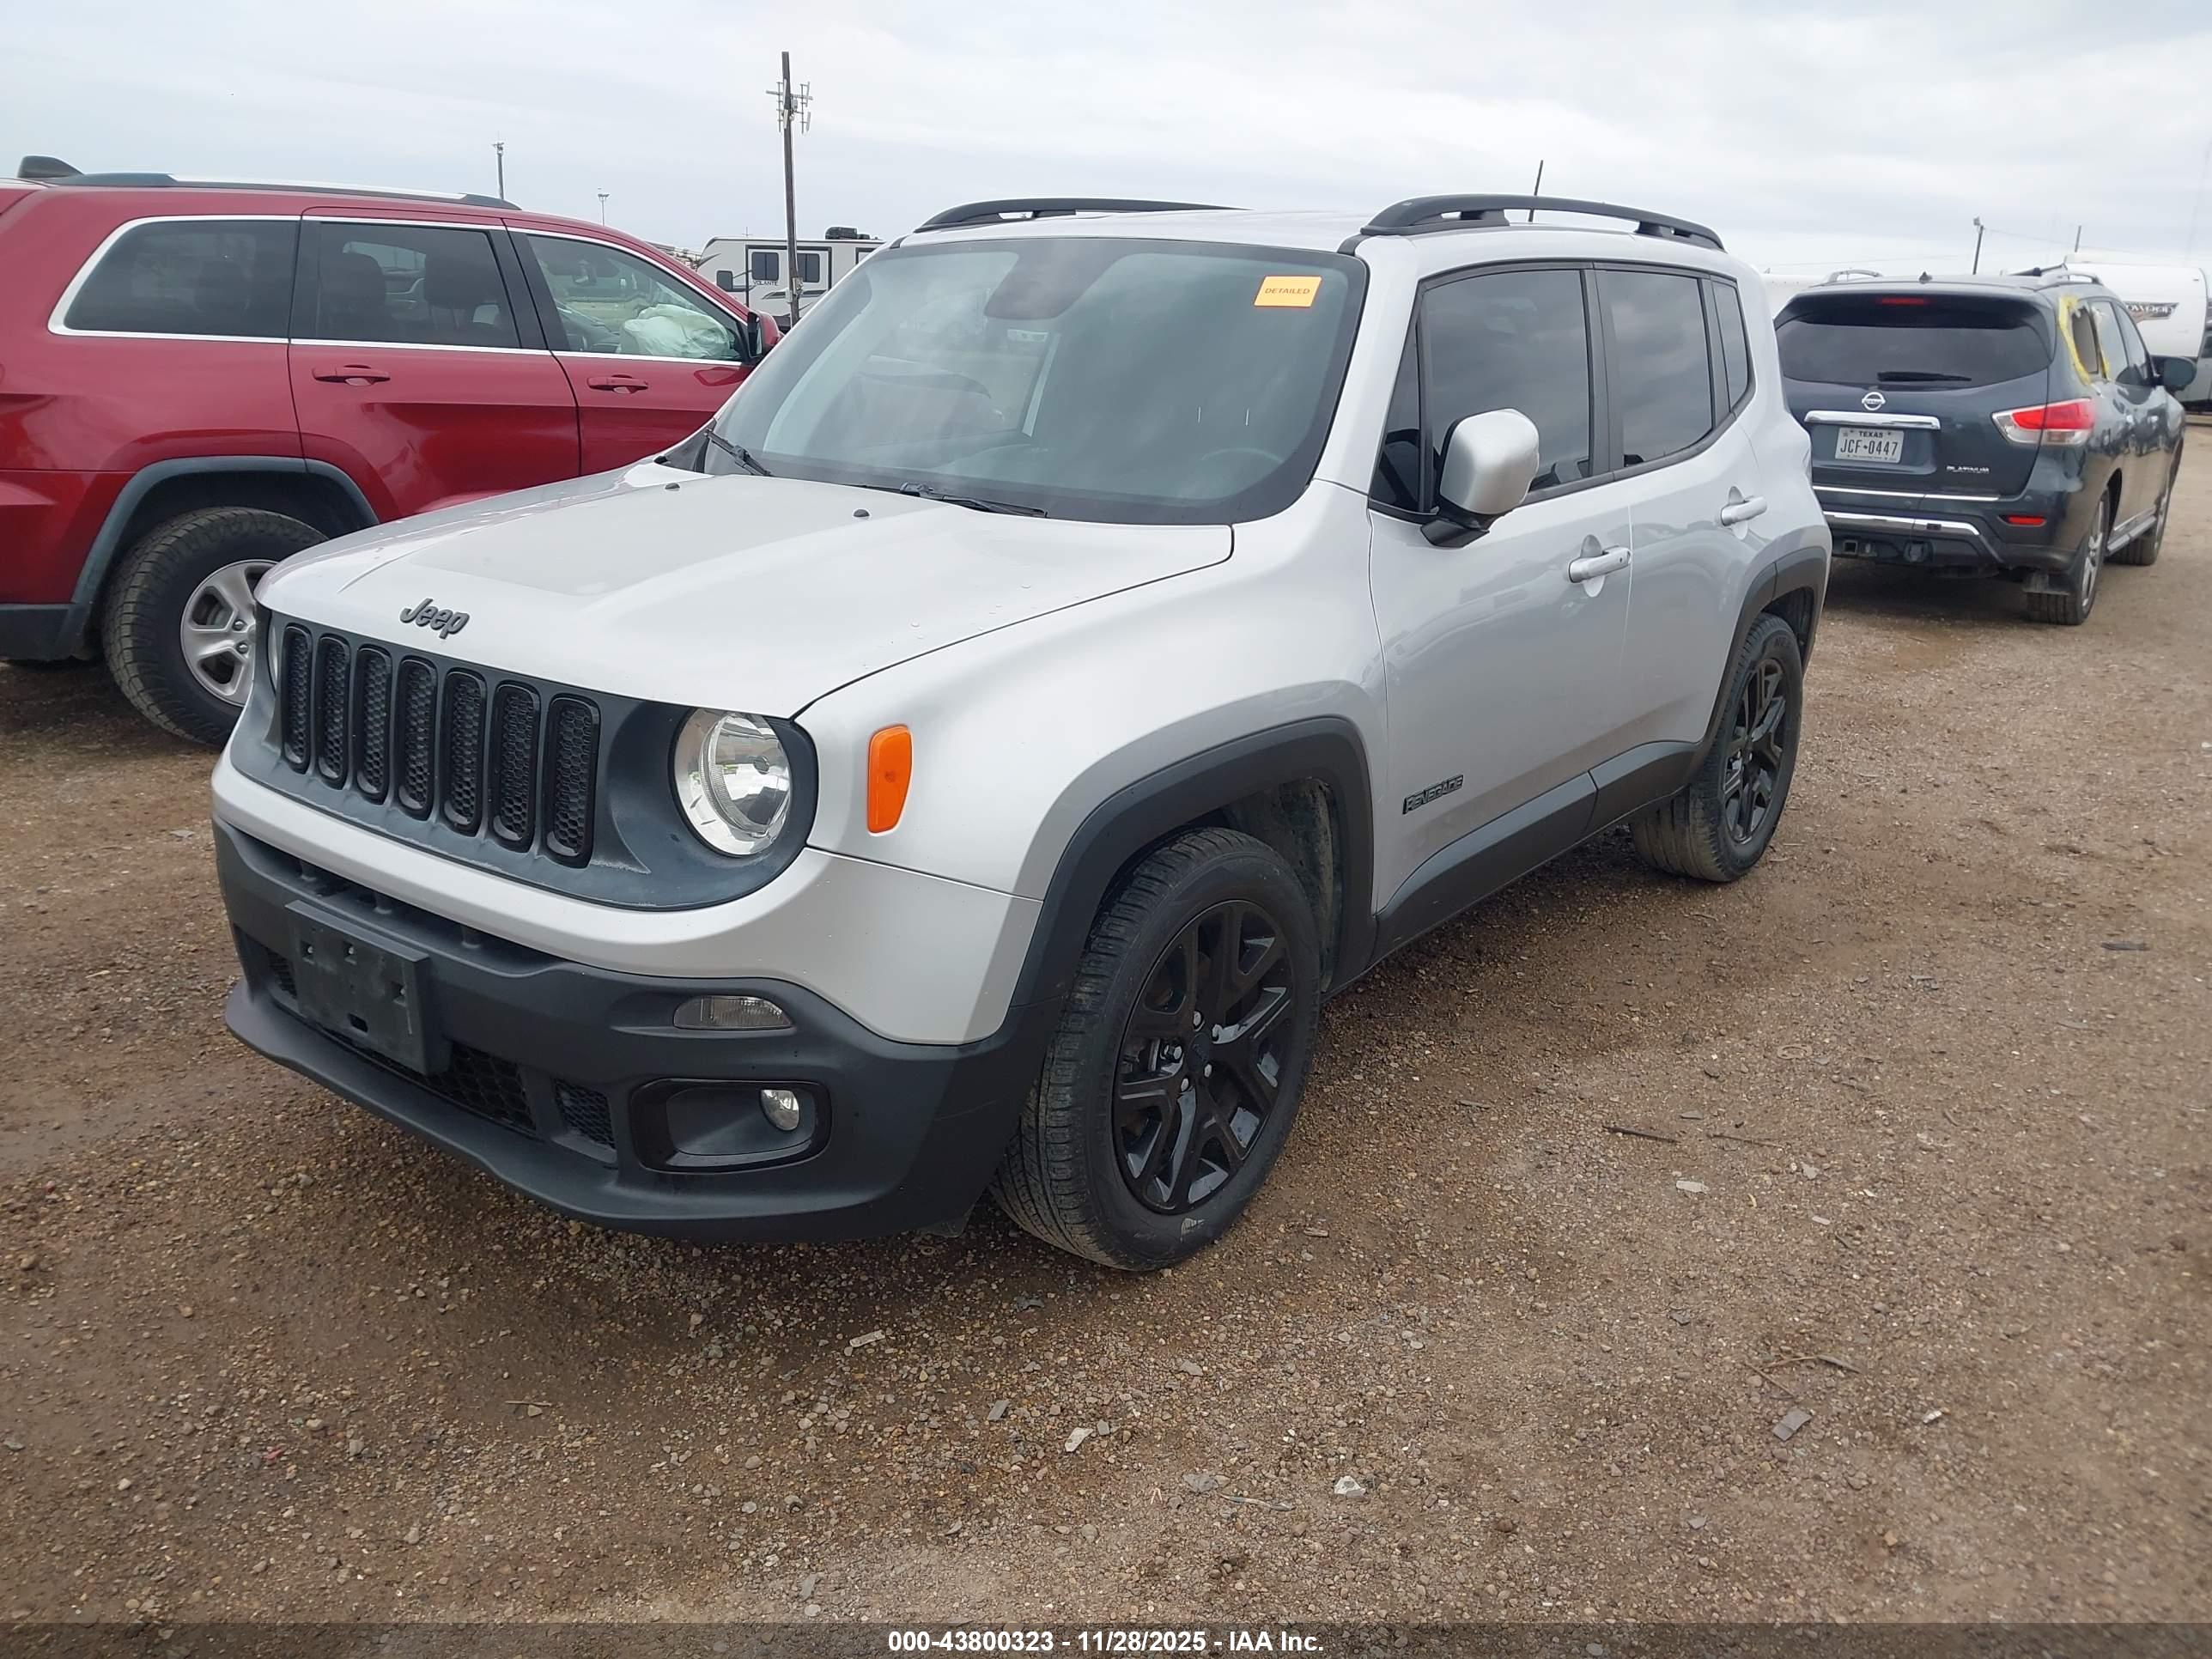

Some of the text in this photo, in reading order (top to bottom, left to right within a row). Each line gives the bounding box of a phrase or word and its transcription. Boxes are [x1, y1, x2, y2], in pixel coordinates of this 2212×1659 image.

[1858, 430, 1884, 439] TEXAS
[398, 598, 471, 640] Jeep
[1401, 774, 1464, 815] RENEGADE
